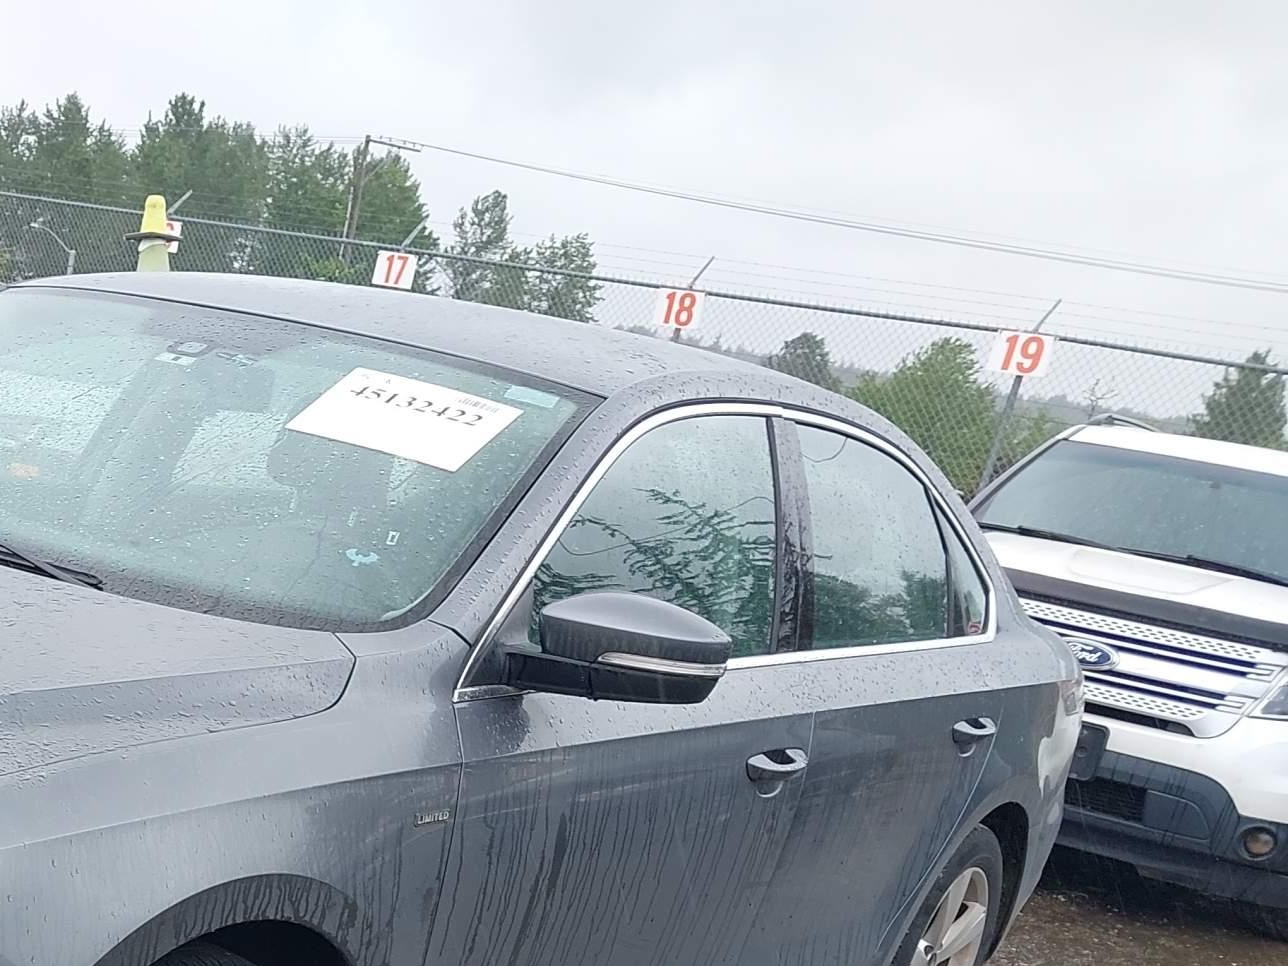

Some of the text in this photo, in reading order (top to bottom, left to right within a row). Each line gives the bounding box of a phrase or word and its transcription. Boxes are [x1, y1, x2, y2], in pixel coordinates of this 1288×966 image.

[384, 254, 409, 285] 17
[663, 291, 697, 326] 18
[1000, 334, 1045, 374] 19
[349, 386, 483, 426] 45132422
